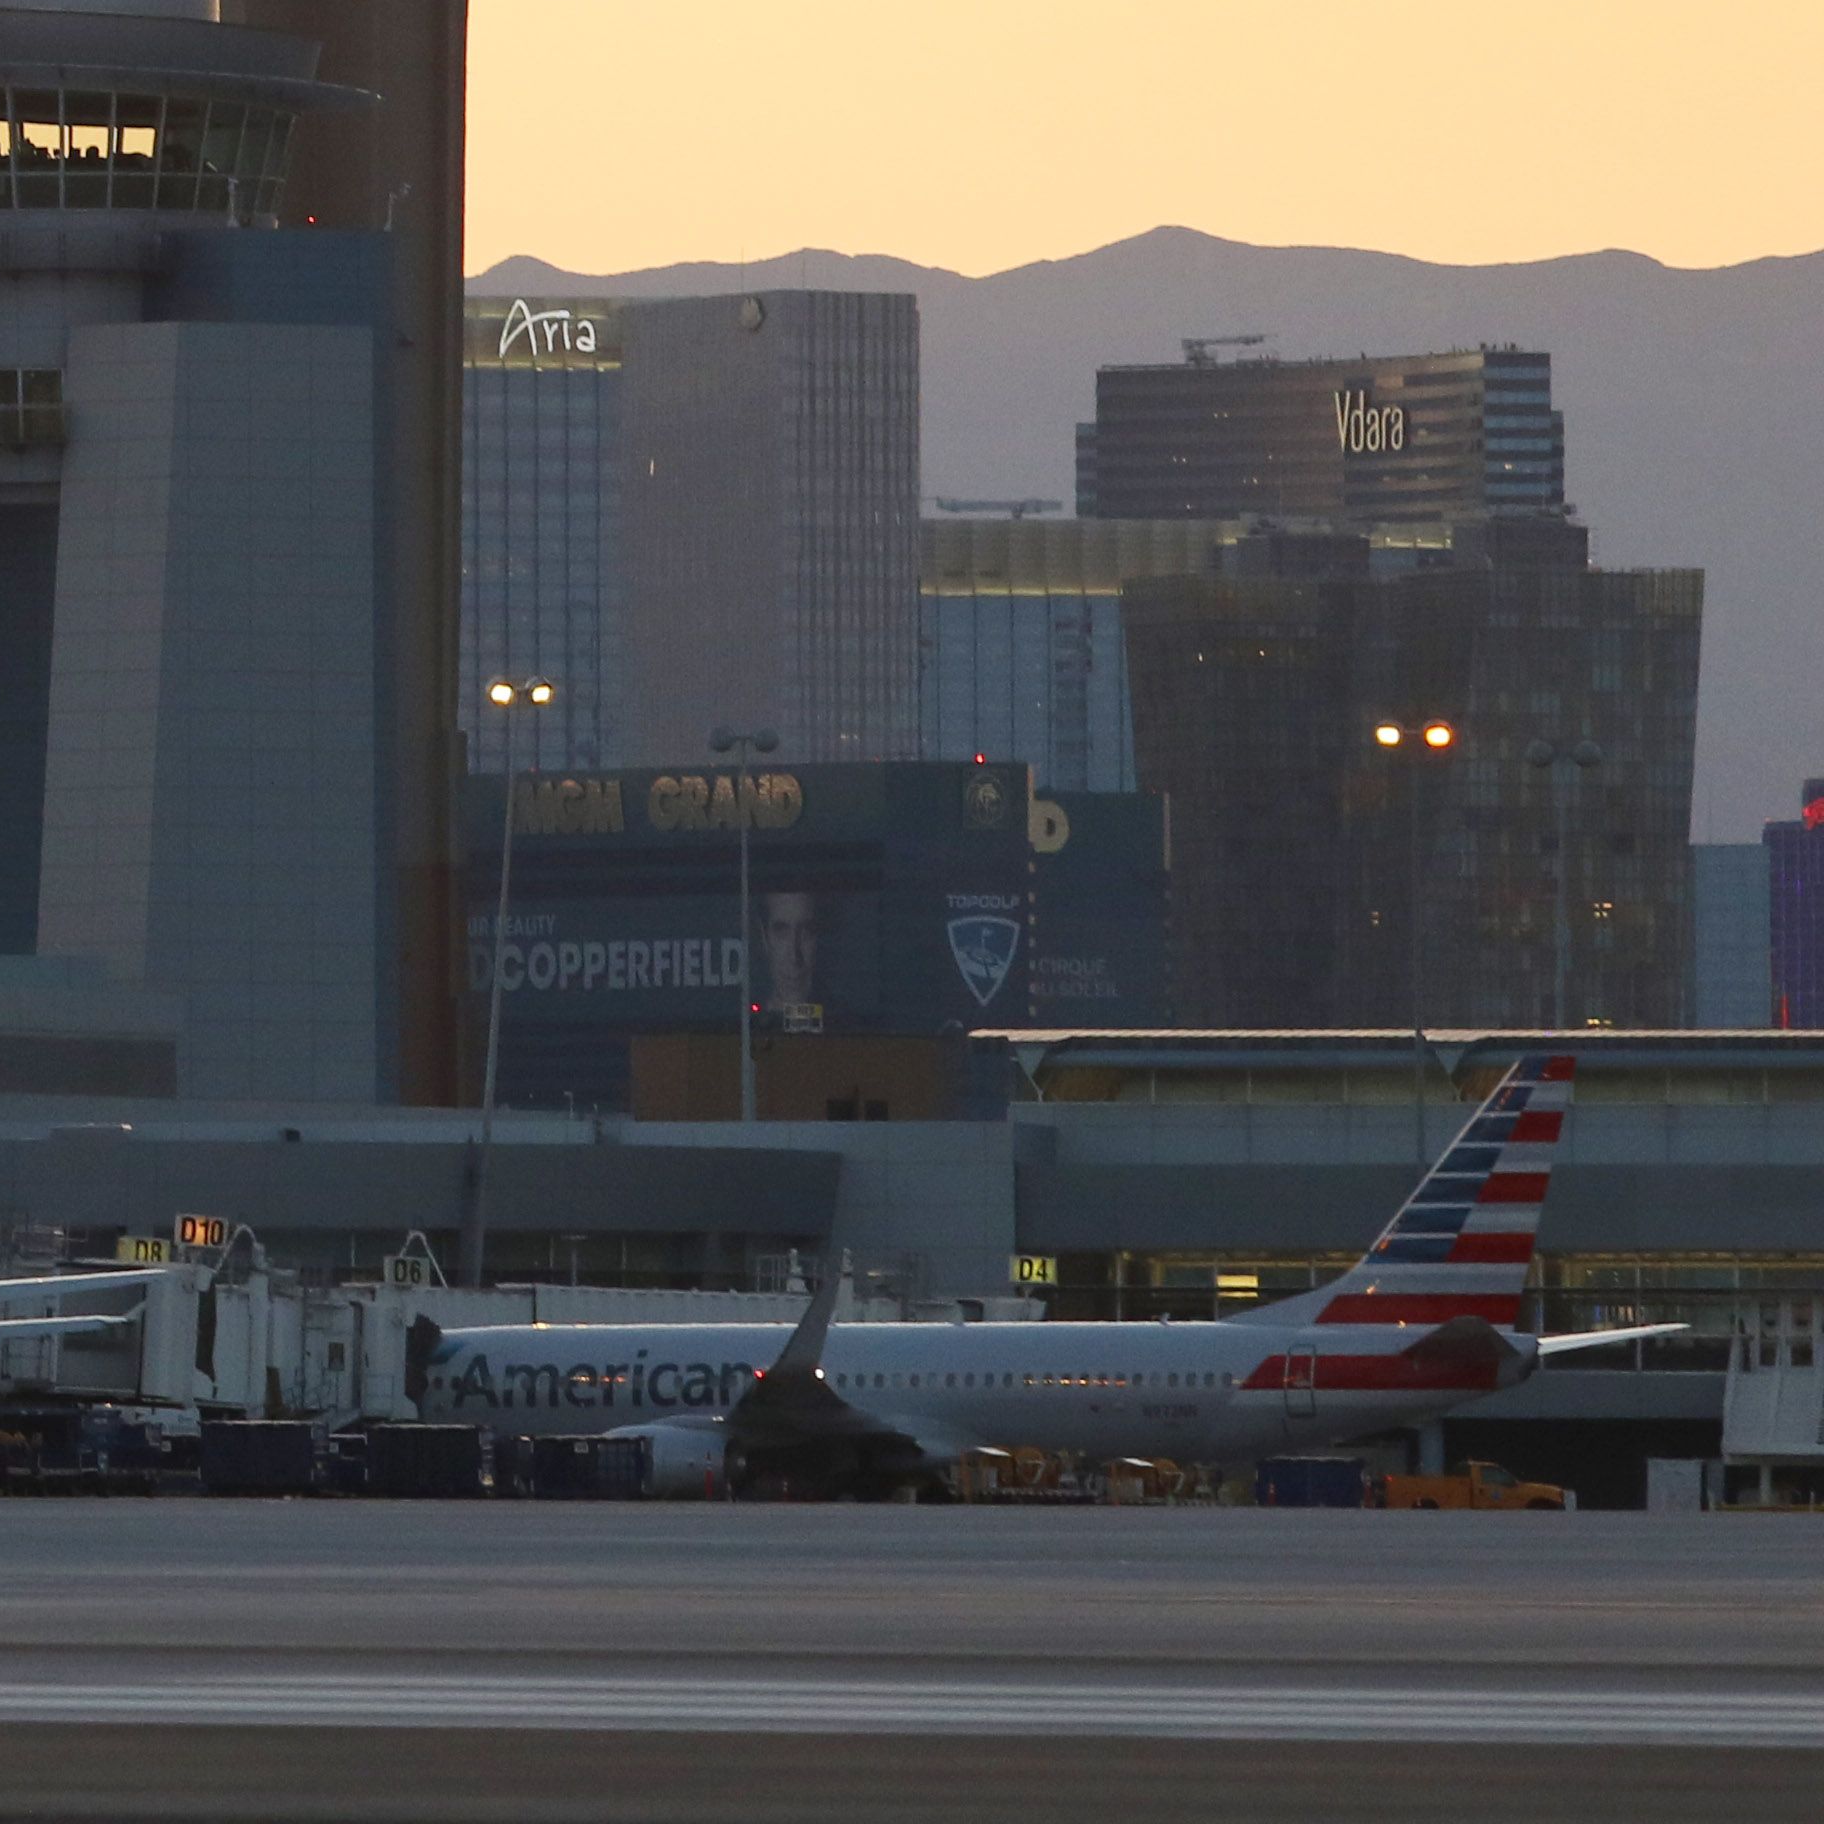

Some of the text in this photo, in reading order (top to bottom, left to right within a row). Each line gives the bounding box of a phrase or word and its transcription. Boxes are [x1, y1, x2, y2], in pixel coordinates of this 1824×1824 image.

[498, 298, 596, 359] Aria
[1334, 389, 1403, 453] Vdara
[510, 773, 802, 835] MGM GRAND
[946, 893, 1021, 910] TOPGOLF
[498, 938, 748, 991] COPPERFIELD
[134, 1239, 162, 1262] D8
[180, 1217, 224, 1246] D10
[393, 1259, 422, 1283] D6
[1018, 1258, 1047, 1281] D4
[452, 1348, 755, 1408] American
